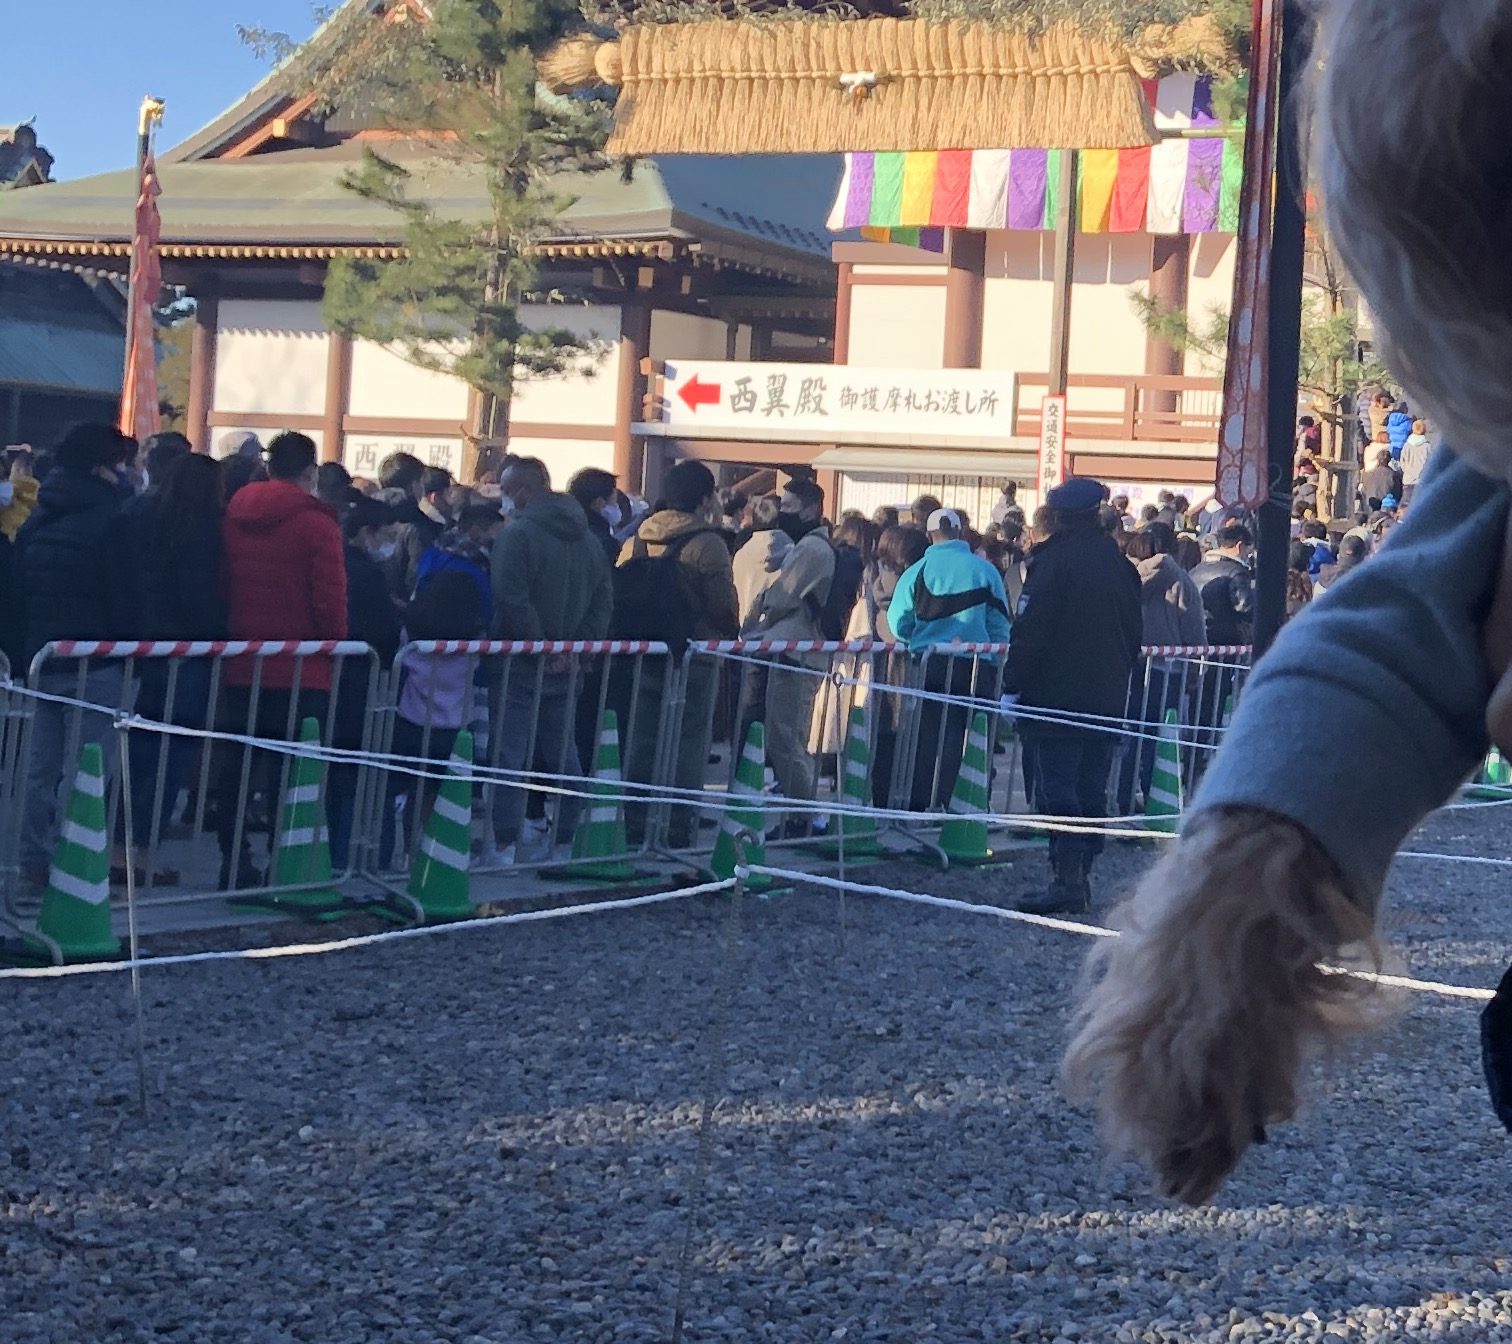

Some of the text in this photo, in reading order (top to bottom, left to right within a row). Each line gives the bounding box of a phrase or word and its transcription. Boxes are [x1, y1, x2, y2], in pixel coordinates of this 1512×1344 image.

[729, 373, 999, 417] 西翼殿 御護摩札お渡し所
